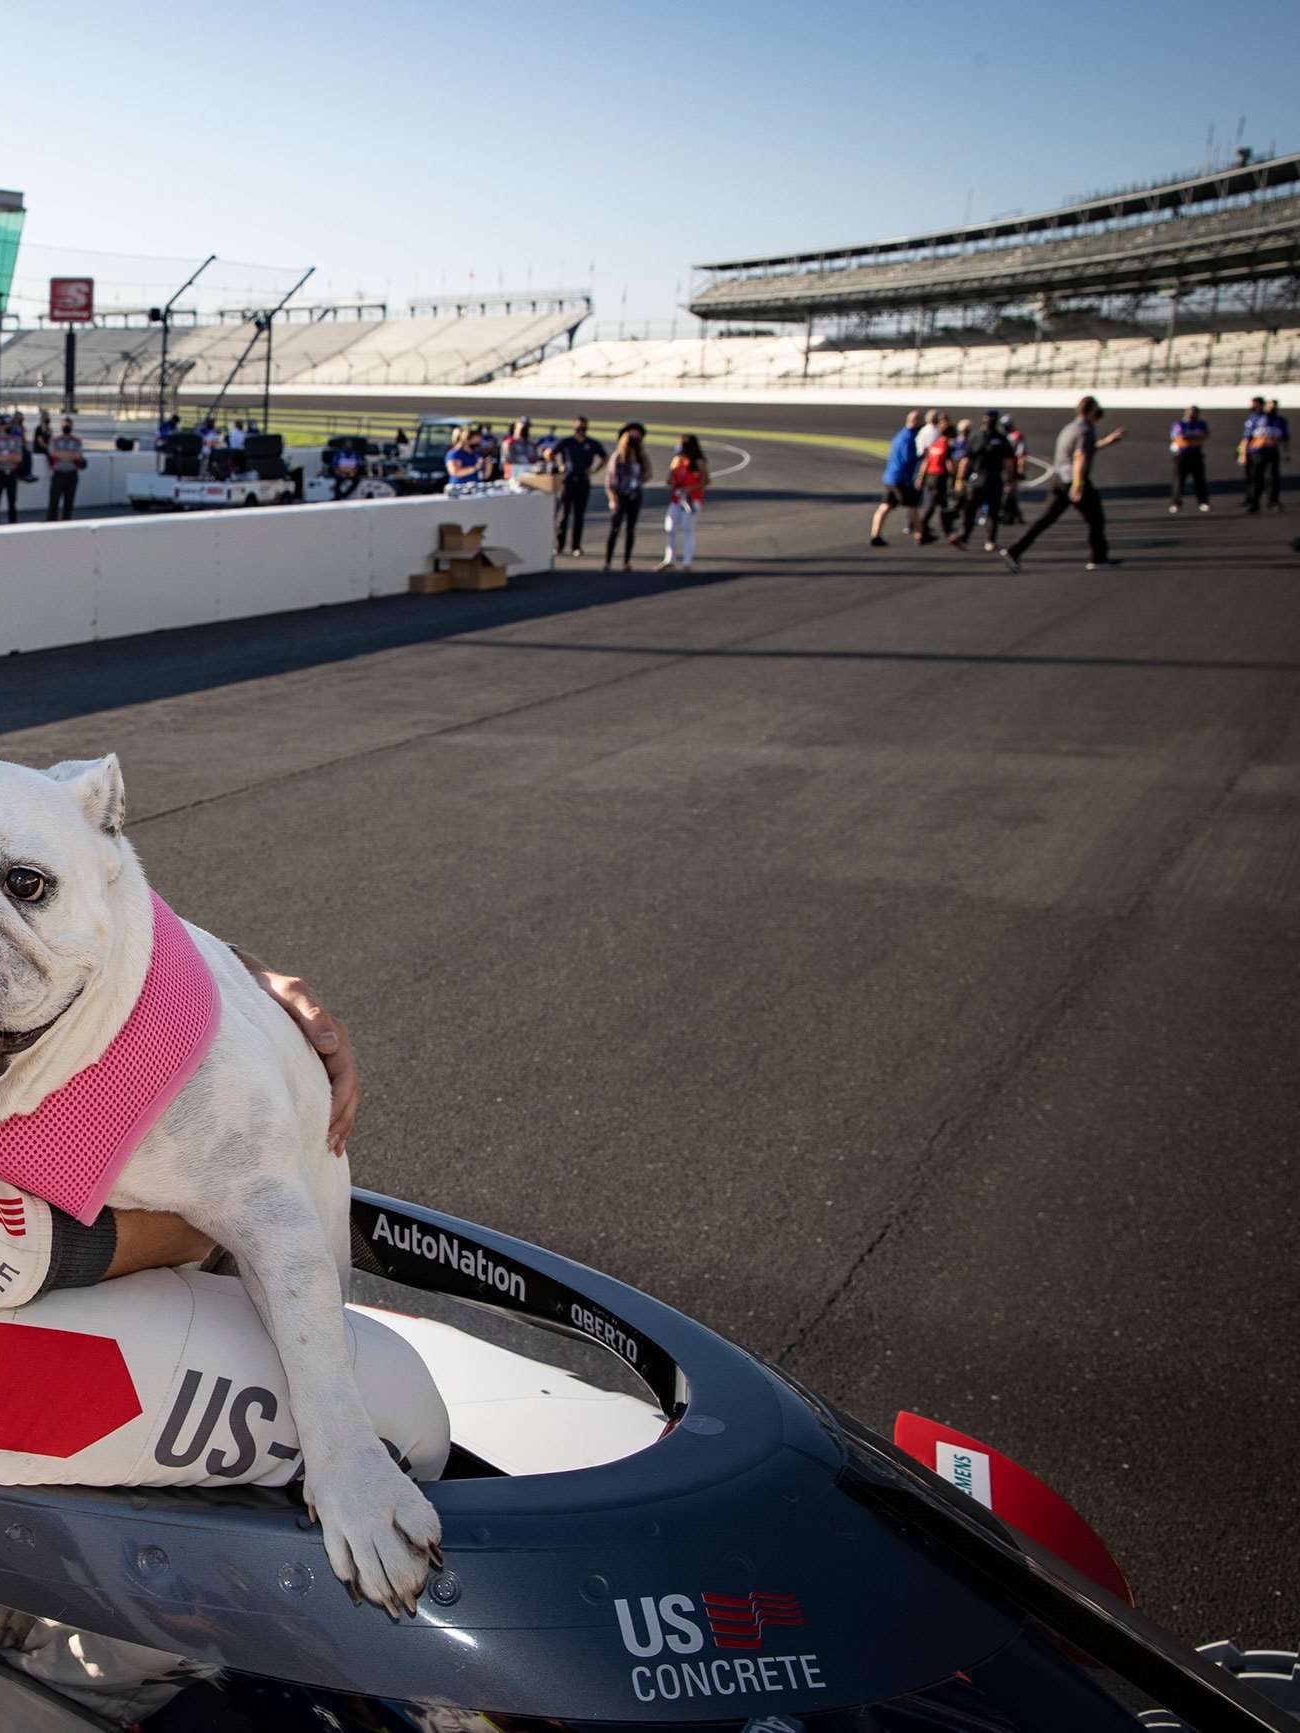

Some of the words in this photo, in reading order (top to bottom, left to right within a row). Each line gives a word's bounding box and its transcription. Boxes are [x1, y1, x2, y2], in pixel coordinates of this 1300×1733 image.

[372, 1213, 526, 1302] AutoNation
[571, 1303, 638, 1363] OBERTO
[154, 1369, 302, 1478] US-
[614, 1594, 704, 1657] US
[631, 1654, 827, 1701] CONCRETE
